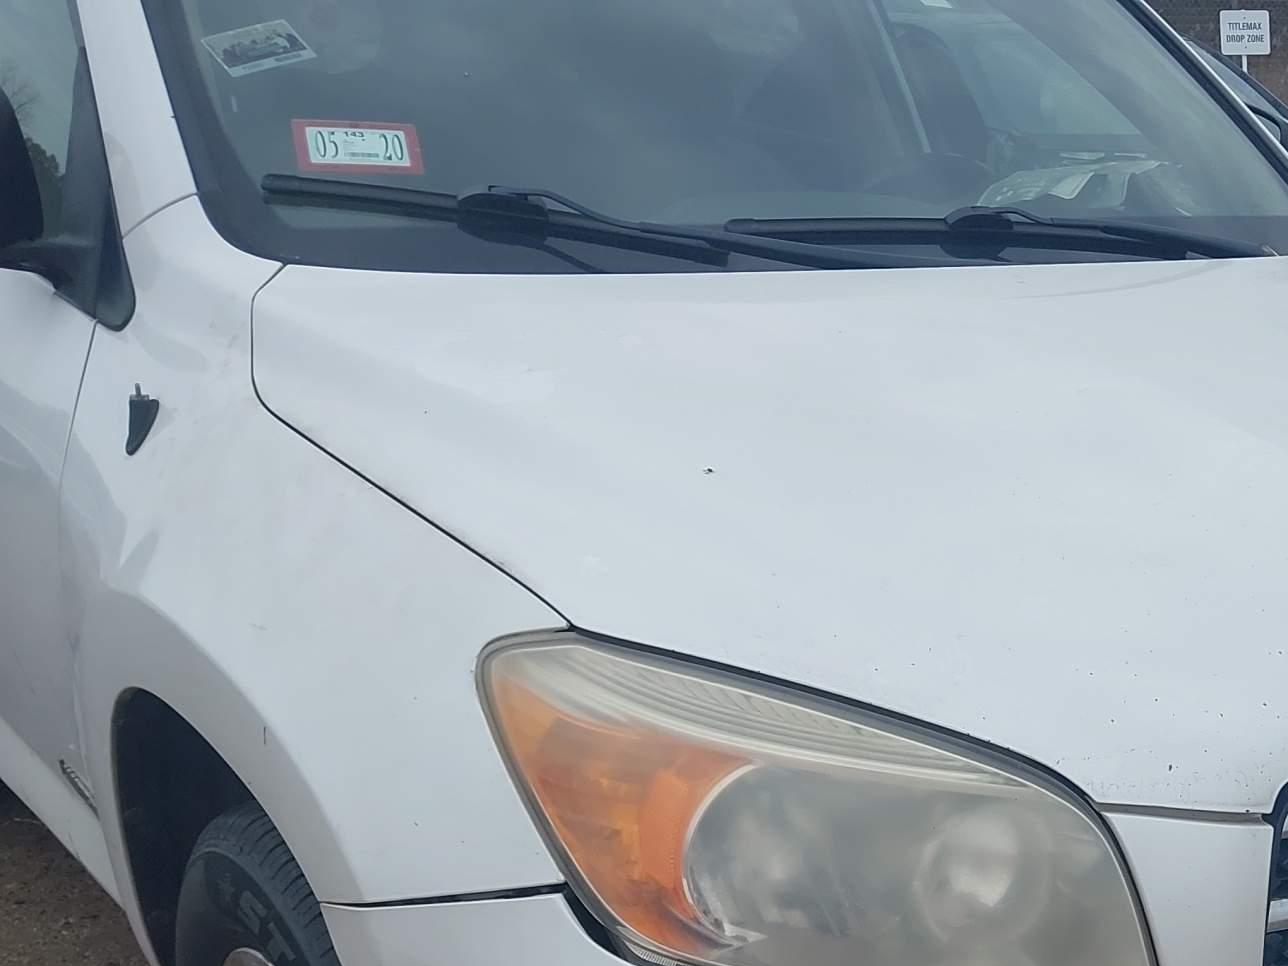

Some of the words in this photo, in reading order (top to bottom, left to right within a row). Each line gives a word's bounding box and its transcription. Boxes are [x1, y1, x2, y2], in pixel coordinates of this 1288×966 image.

[1227, 22, 1262, 31] TITLEMAX
[1226, 34, 1245, 43] DROP
[1247, 34, 1265, 43] ZONE
[315, 130, 339, 159] 05
[379, 133, 404, 161] 20
